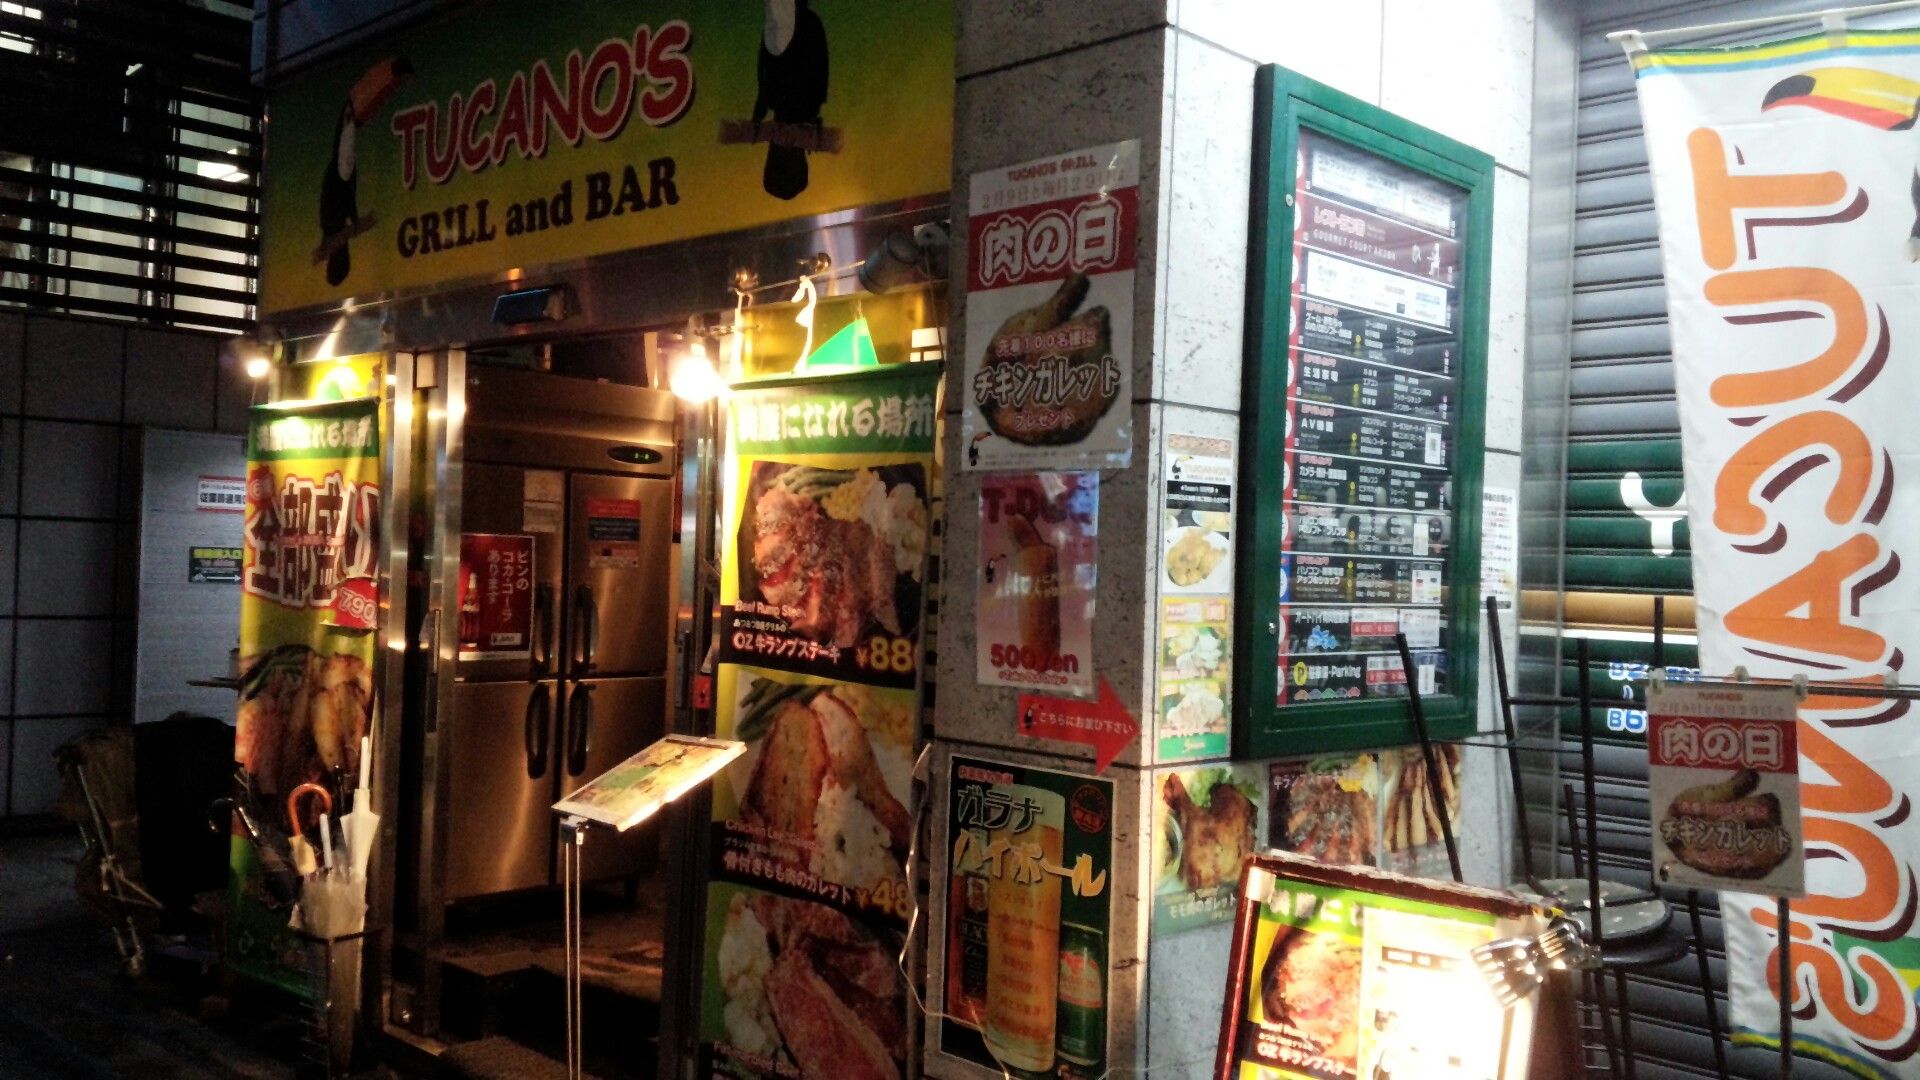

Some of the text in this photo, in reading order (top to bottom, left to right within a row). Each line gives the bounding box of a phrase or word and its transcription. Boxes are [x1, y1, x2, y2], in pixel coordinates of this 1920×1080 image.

[391, 18, 696, 192] TUCANO'S
[396, 156, 680, 260] GRILL and BAR
[980, 199, 1123, 286] 肉の日
[973, 355, 1121, 409] チキンガレット
[501, 550, 515, 622] コカ・コーラ
[733, 632, 842, 664] OZ牛ランプステーキ
[1607, 707, 1648, 734] B6
[1659, 719, 1783, 770] 肉の日
[957, 784, 1044, 834] ガラナ
[1660, 815, 1793, 854] チキンガレット
[953, 828, 1107, 898] ハイボール
